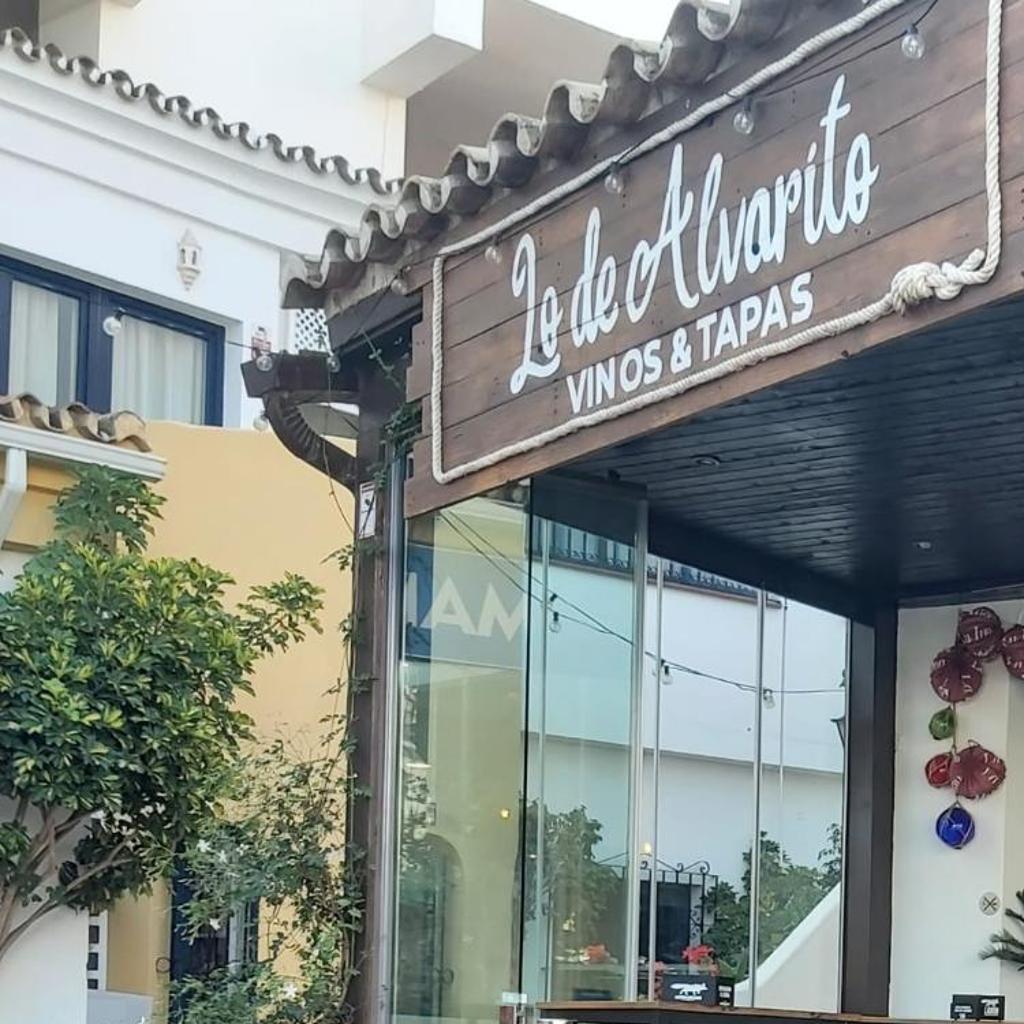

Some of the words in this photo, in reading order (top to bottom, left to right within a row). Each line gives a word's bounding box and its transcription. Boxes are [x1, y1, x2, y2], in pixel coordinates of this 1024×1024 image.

[510, 233, 563, 394] Lo
[570, 207, 619, 348] de
[625, 74, 880, 322] Alvarito
[566, 338, 663, 414] VINOS
[670, 327, 692, 374] &
[696, 272, 814, 362] TAPAS
